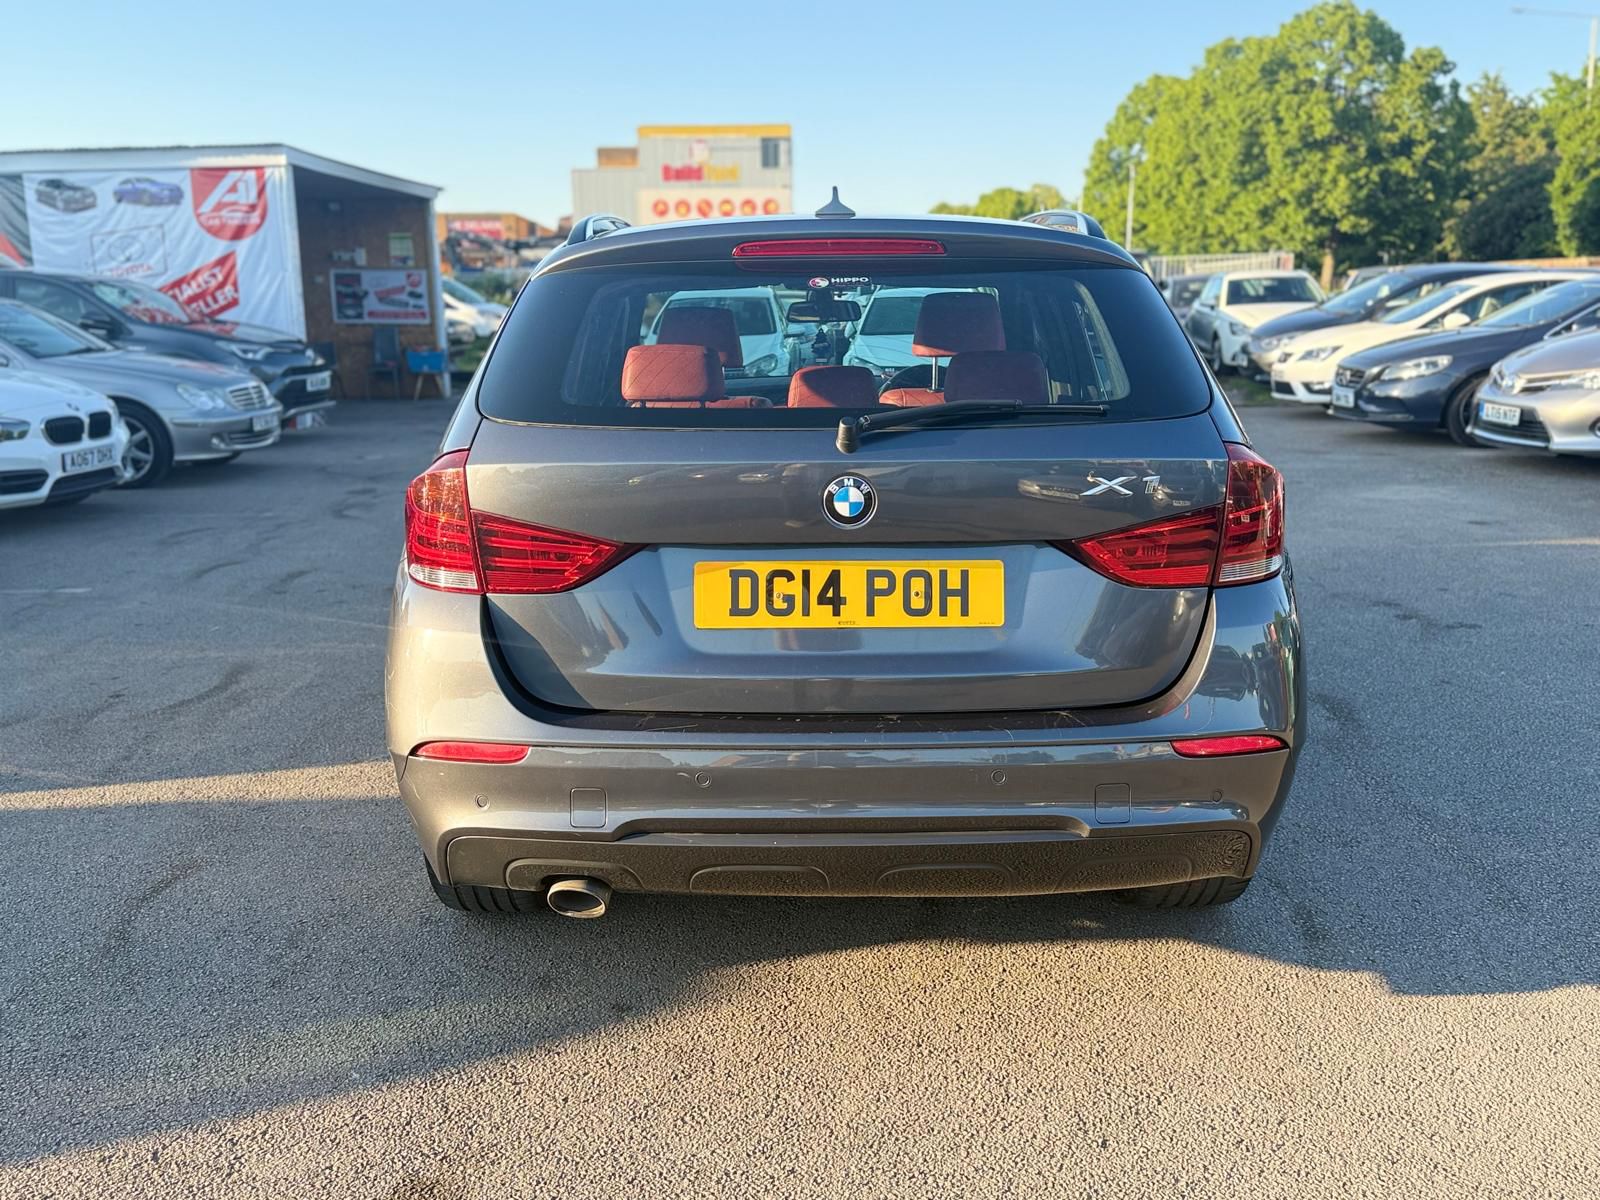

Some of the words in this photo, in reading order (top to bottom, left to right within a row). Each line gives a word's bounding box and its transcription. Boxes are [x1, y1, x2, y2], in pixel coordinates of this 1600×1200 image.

[168, 266, 224, 302] IALIST
[187, 283, 239, 320] ELLER
[829, 478, 870, 495] BMW
[728, 568, 847, 617] DG14
[865, 568, 970, 617] POH
